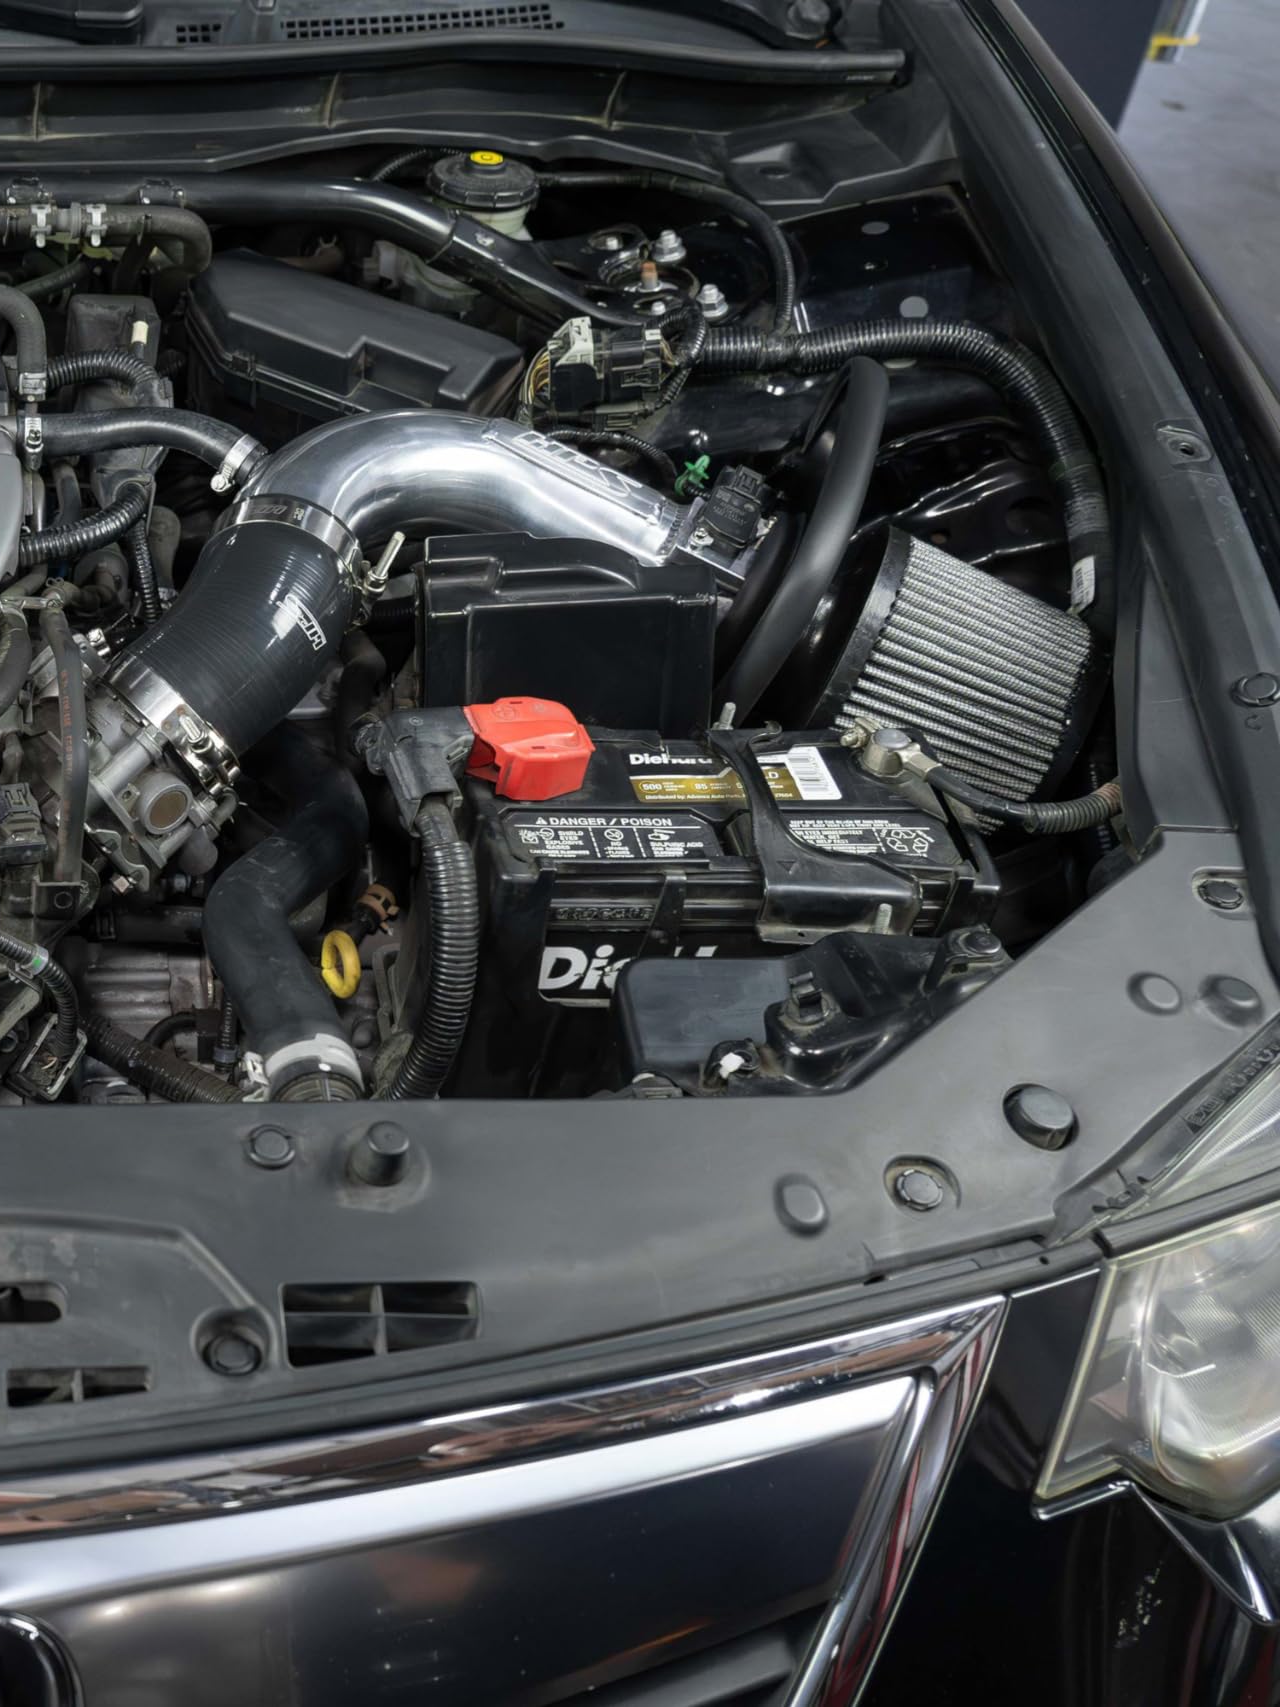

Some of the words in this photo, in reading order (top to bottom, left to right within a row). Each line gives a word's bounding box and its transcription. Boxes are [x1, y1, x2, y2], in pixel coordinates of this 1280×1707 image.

[642, 783, 662, 791] 500
[549, 817, 607, 826] DANGER
[620, 818, 672, 826] POISON
